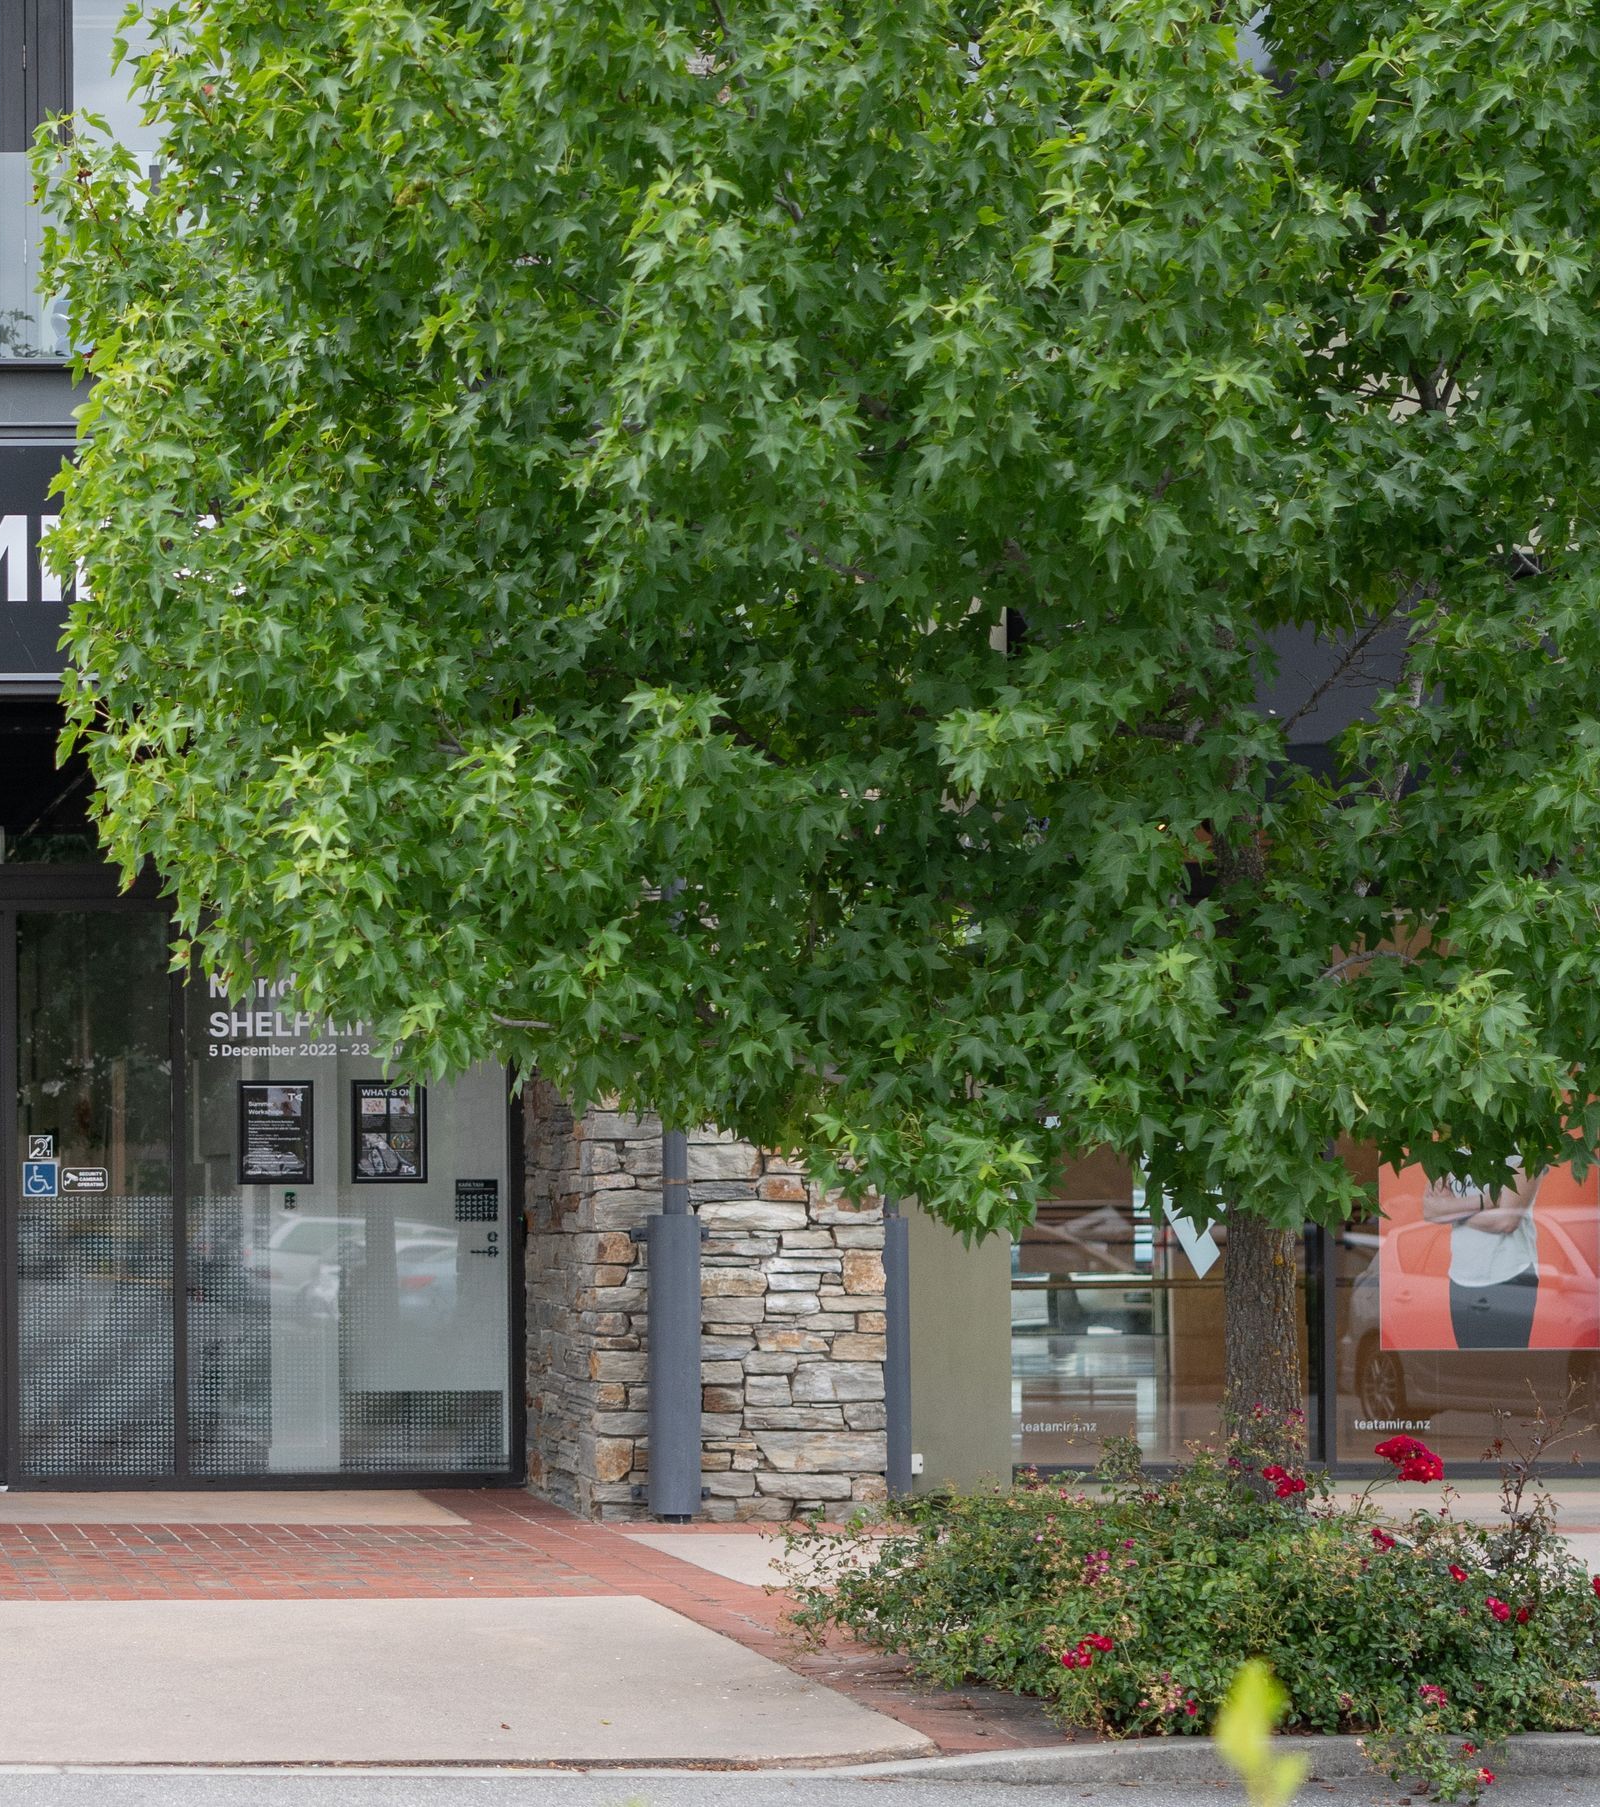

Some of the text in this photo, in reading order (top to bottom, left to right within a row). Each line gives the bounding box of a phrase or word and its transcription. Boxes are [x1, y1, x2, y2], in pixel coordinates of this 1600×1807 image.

[208, 1044, 218, 1056] 5
[221, 1044, 296, 1056] December
[300, 1044, 336, 1056] 2022
[352, 1043, 369, 1055] 23
[1021, 1422, 1097, 1432] teatamira.nz
[1354, 1418, 1431, 1432] teatamira.nz
